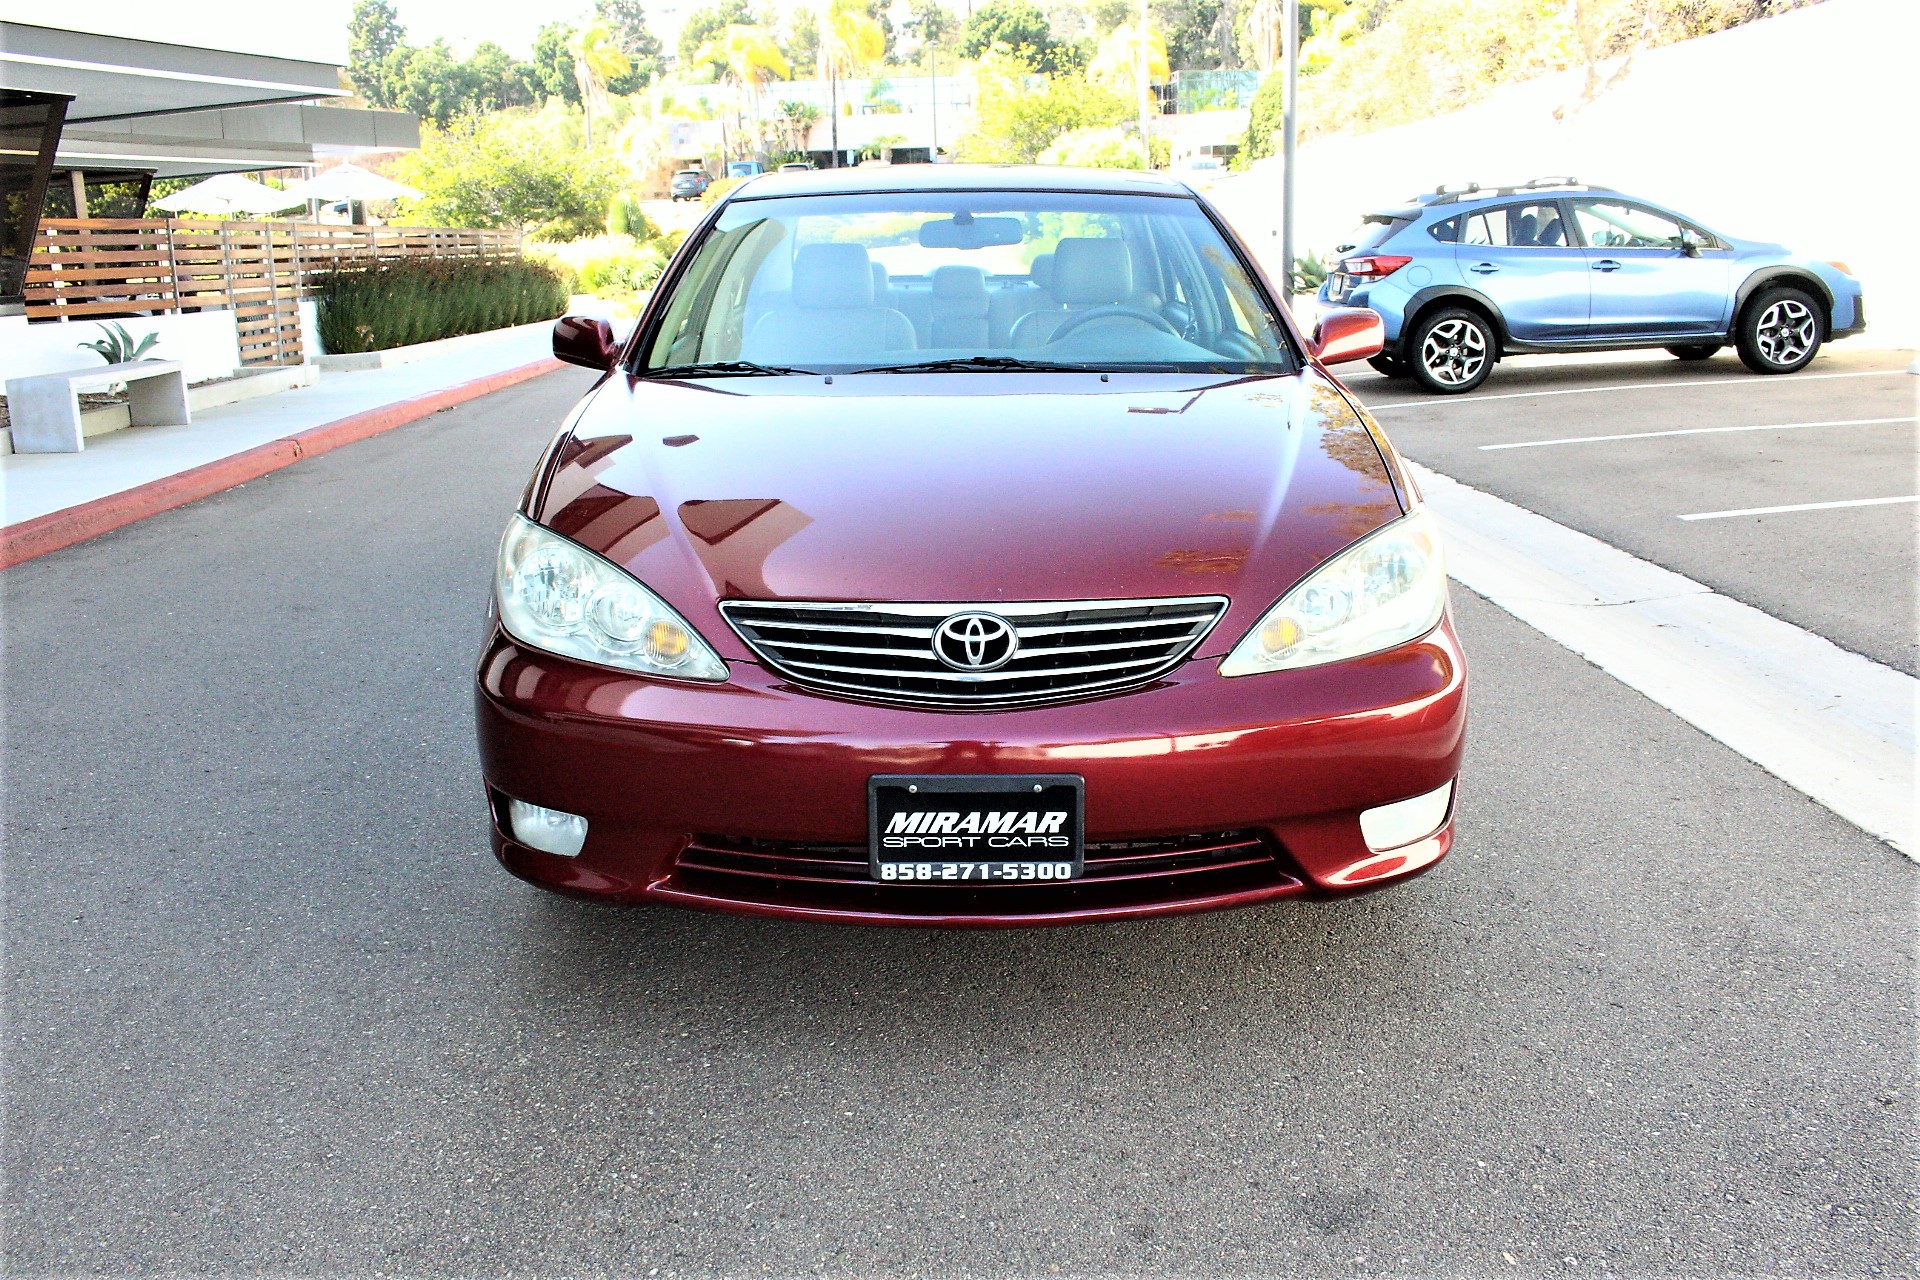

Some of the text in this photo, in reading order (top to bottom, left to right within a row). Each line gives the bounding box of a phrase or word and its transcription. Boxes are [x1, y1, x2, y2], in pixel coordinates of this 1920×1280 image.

[884, 811, 1068, 834] MIRAMAR
[882, 836, 1069, 848] SPORT CARS
[880, 863, 1072, 880] 858-271-5300
